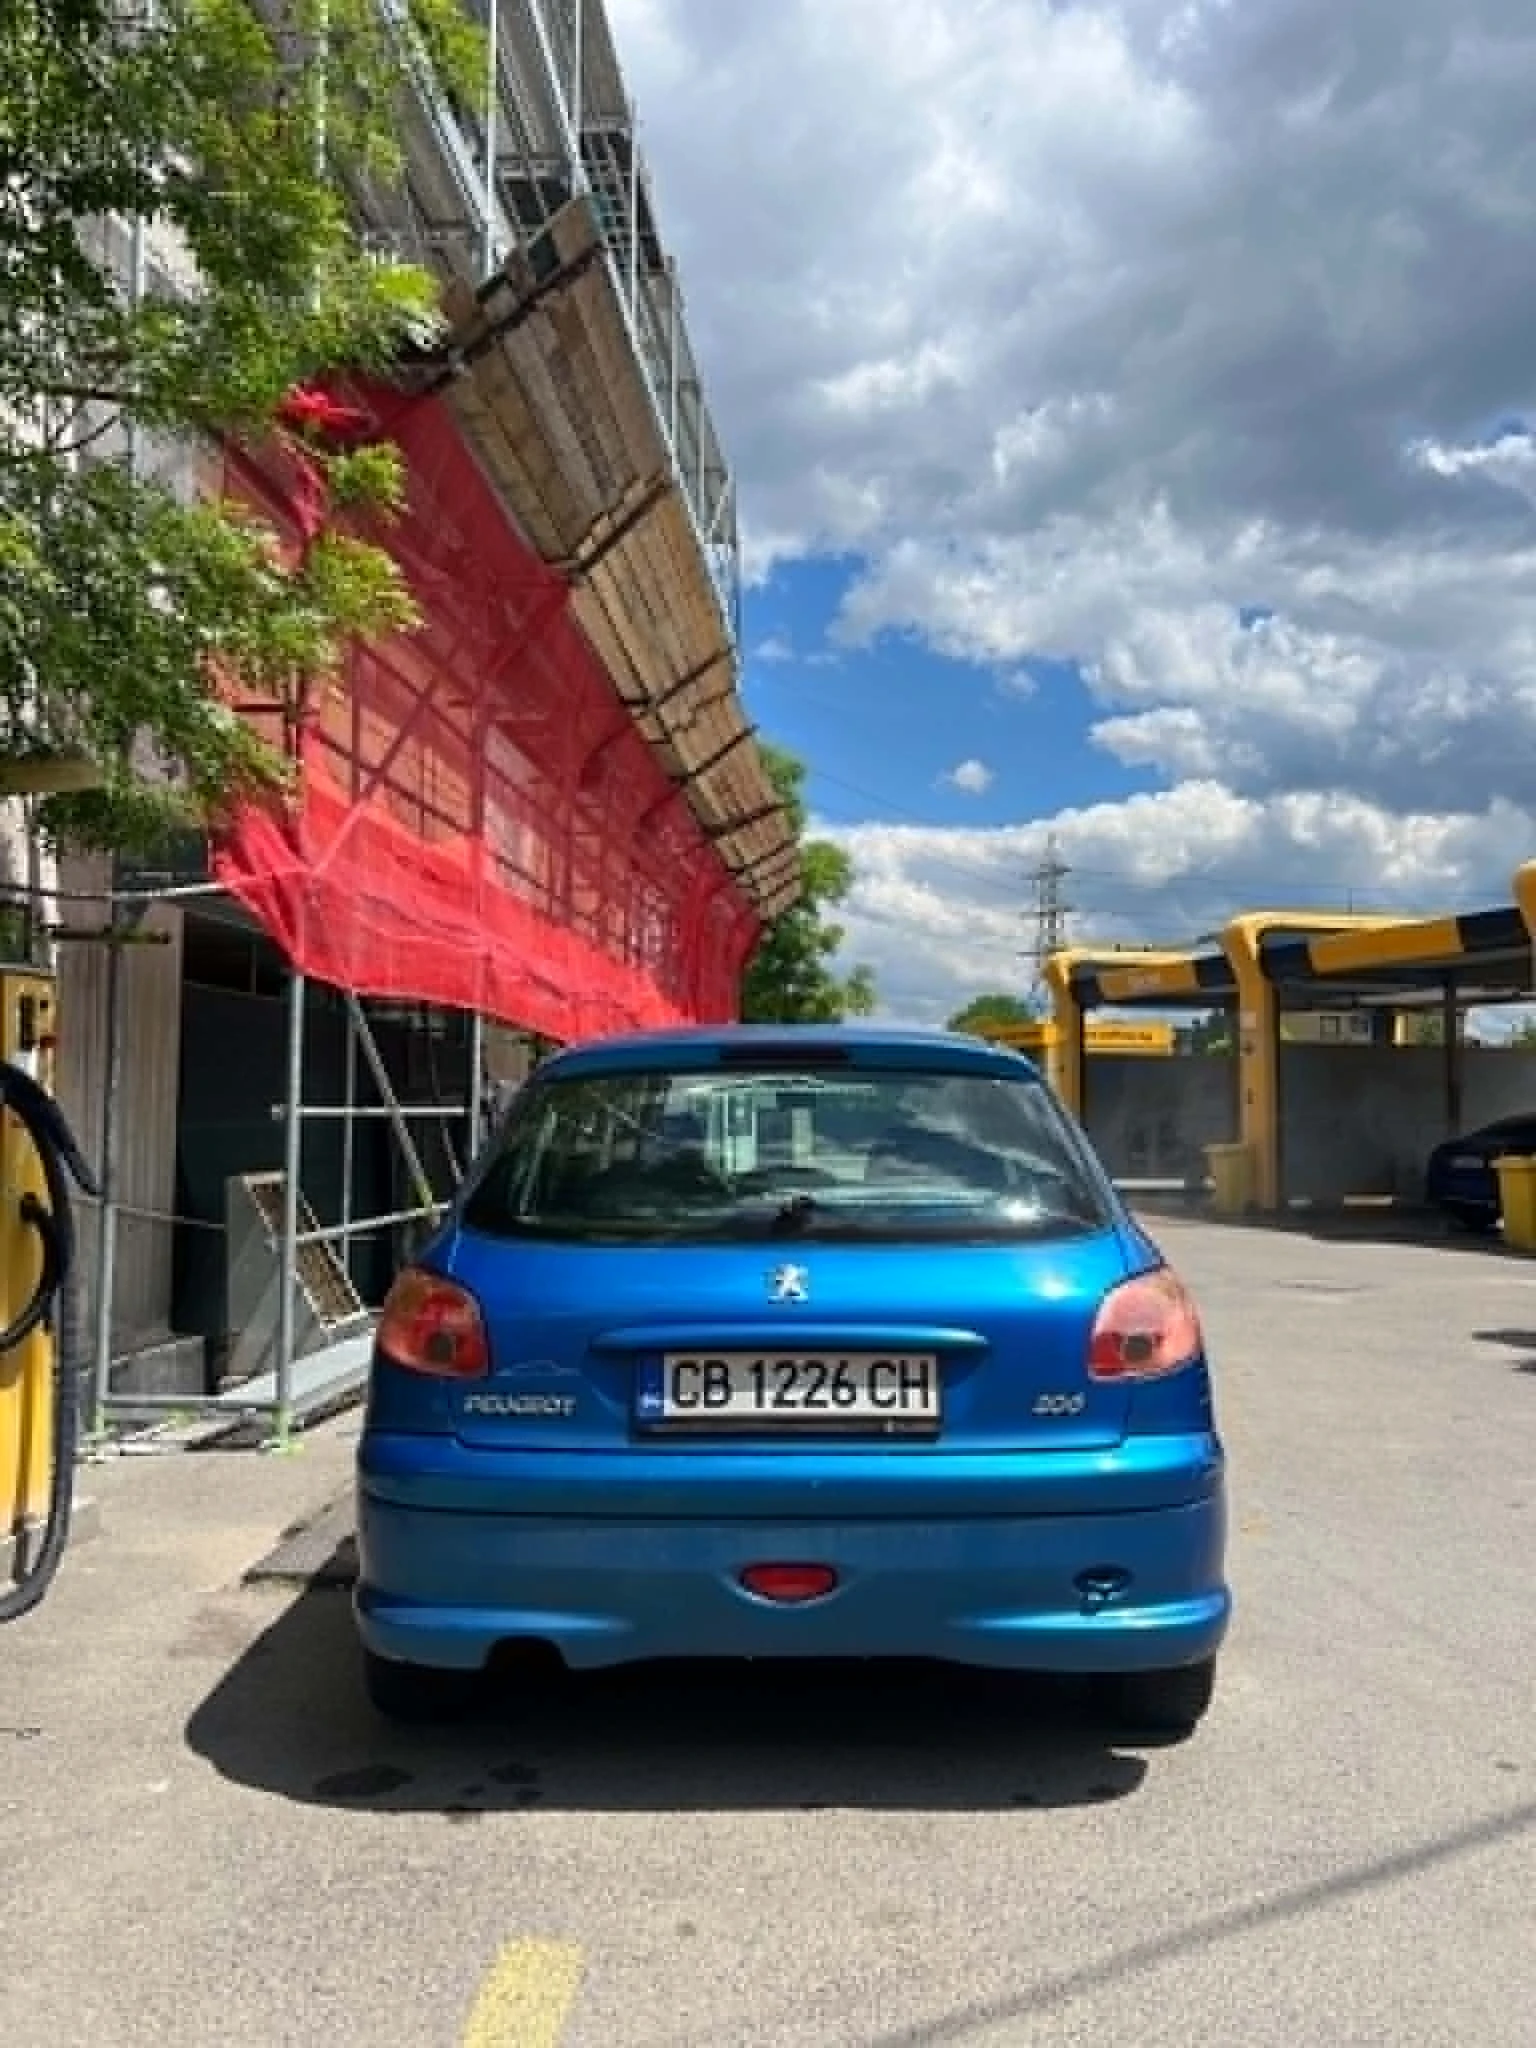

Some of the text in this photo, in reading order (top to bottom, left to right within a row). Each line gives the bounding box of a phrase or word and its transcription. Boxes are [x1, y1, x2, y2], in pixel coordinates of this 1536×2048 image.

[671, 1359, 929, 1408] CB 1226 CH
